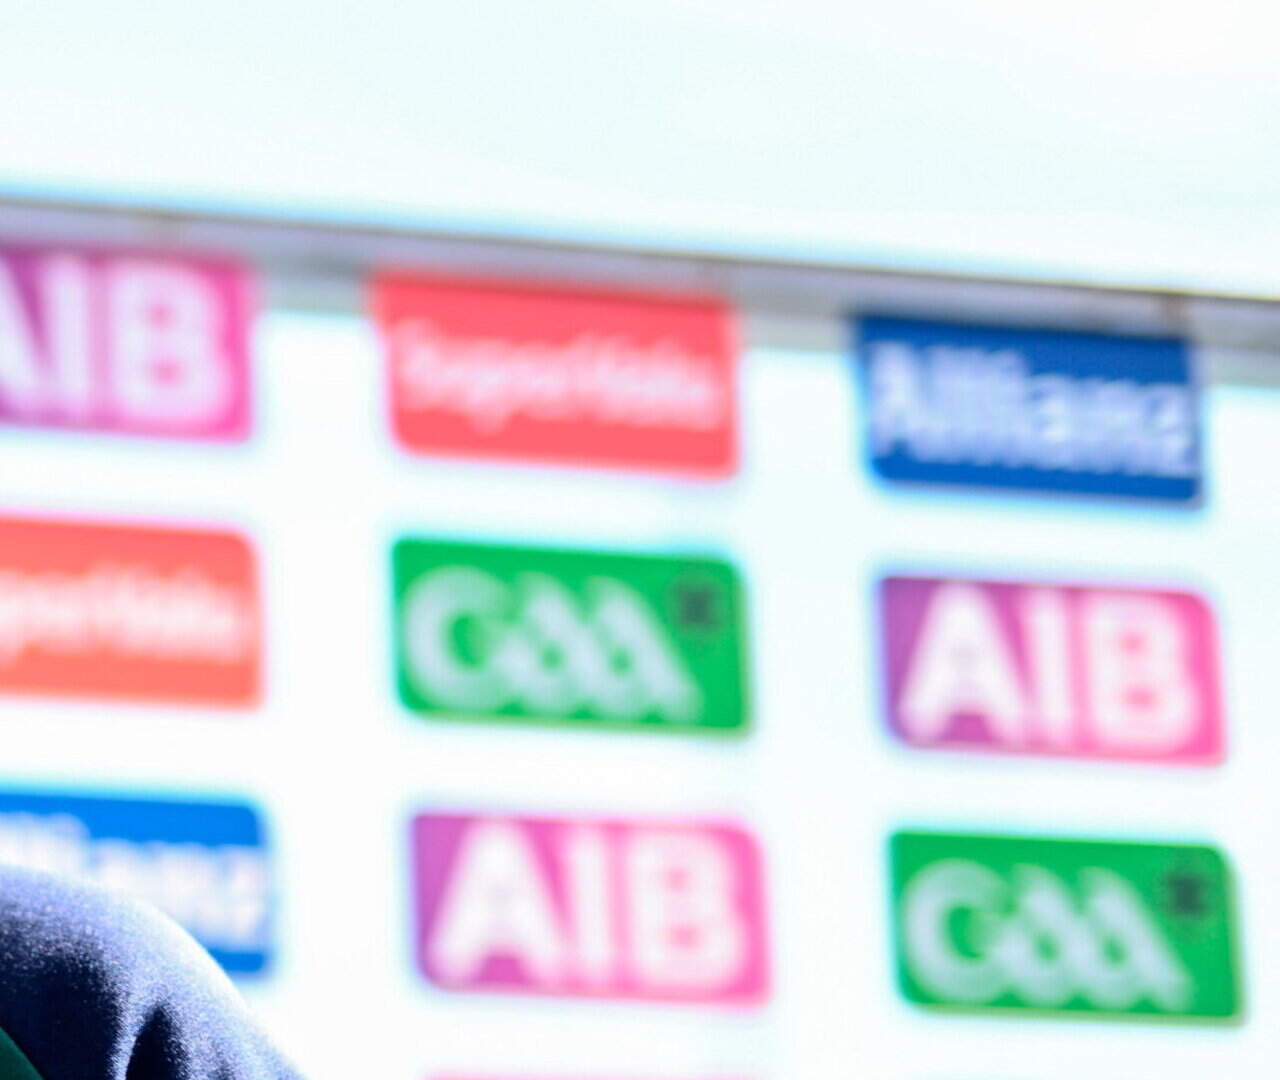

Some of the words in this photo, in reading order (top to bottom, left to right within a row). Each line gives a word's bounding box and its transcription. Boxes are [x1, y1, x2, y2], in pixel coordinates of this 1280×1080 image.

[866, 340, 1198, 478] Allianz
[896, 580, 1202, 754] AIB
[424, 818, 748, 994] AIB
